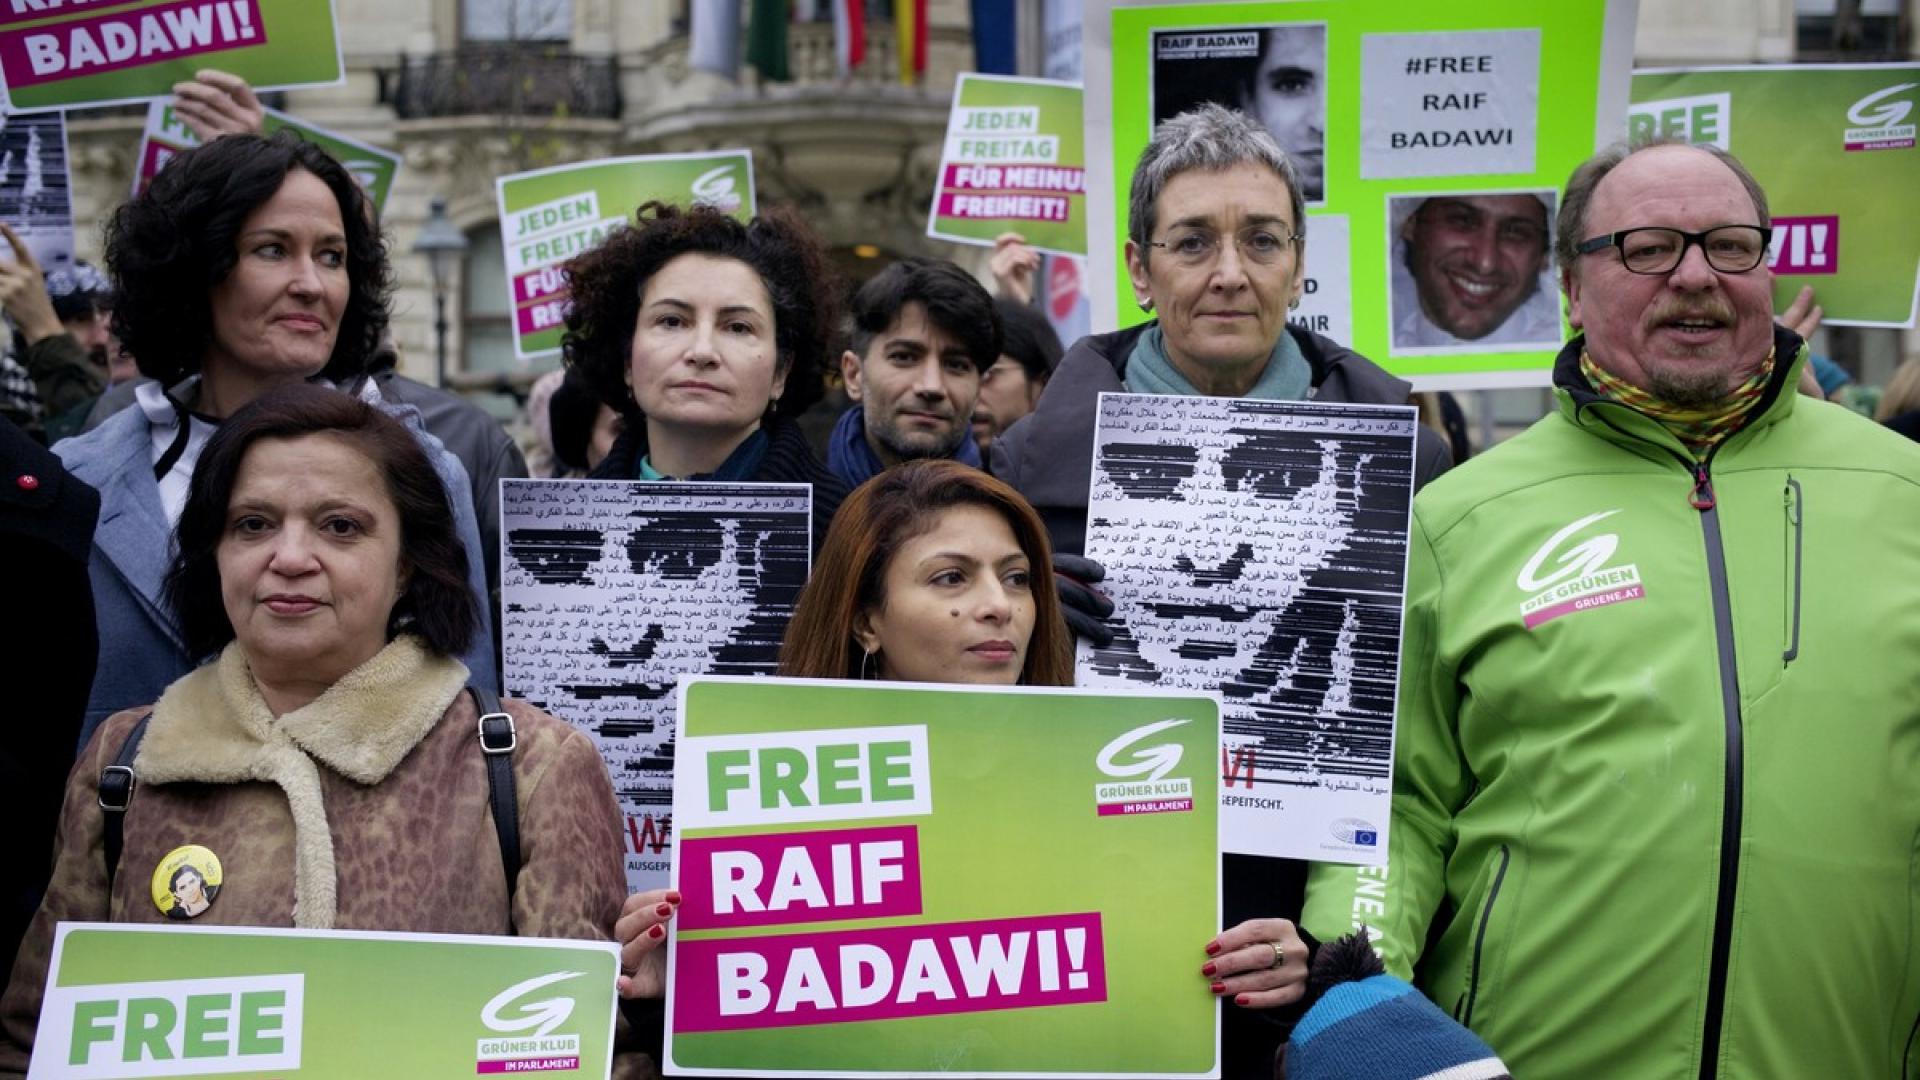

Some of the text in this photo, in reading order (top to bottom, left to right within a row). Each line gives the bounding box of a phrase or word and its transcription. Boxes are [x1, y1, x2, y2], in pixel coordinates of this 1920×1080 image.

[24, 1, 256, 75] BADAWI!
[1160, 35, 1256, 49] RAIF BADAWI
[1406, 56, 1492, 74] #FREE
[1423, 93, 1487, 110] RAIF
[963, 112, 1033, 129] JEDEN
[961, 141, 1053, 158] FREITAG
[1391, 128, 1513, 150] BADAWI
[955, 165, 1087, 191] FÜR MEINU
[518, 198, 591, 235] JEDEN
[952, 196, 1066, 219] FREIHEIT!
[1525, 569, 1634, 610] DIE GRÜNEN
[1575, 588, 1640, 609] GRUENE.AT
[707, 741, 915, 812] FREE
[1100, 783, 1188, 798] GRÜNER KLUB
[1124, 801, 1190, 813] IM PARLAMENT
[711, 840, 904, 915] RAIF
[717, 927, 1088, 1017] BADAWI!
[69, 990, 286, 1065] FREE
[481, 1039, 576, 1055] GRÜNER KLUB
[505, 1059, 577, 1071] IM PARLAMENT
